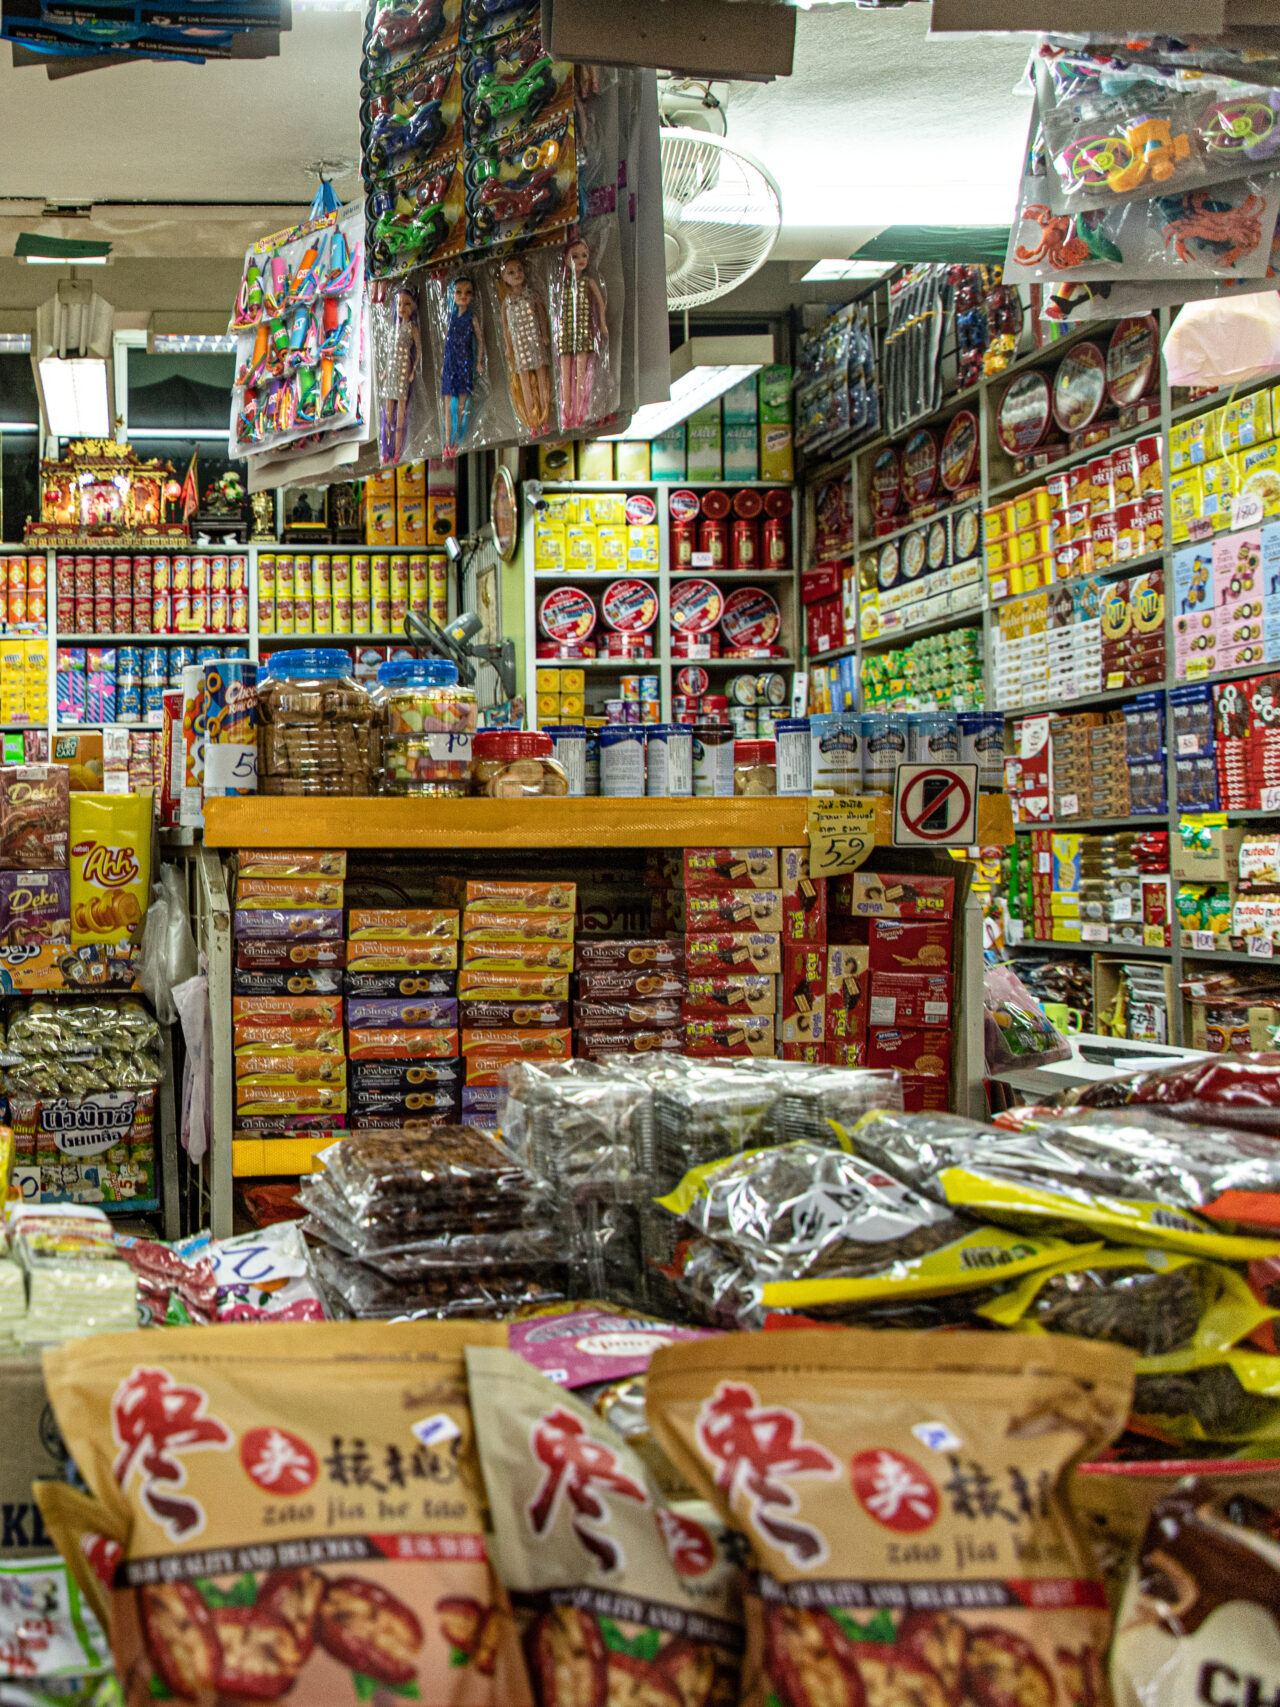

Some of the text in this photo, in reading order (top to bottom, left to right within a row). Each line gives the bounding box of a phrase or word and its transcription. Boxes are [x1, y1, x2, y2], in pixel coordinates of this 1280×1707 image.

[8, 782, 58, 804] Deka
[820, 837, 865, 868] 52
[242, 883, 296, 894] Dewberry
[9, 889, 58, 911] Deka
[354, 943, 409, 955] Dewberry
[467, 973, 523, 986] Dewberry
[586, 976, 634, 988] Dewberry
[239, 999, 295, 1012] Dewberry
[357, 1066, 405, 1078] Dewberry
[263, 1505, 314, 1525] zao
[326, 1495, 364, 1526] jia
[423, 1496, 467, 1519] tao
[887, 1535, 998, 1569] zao jia
